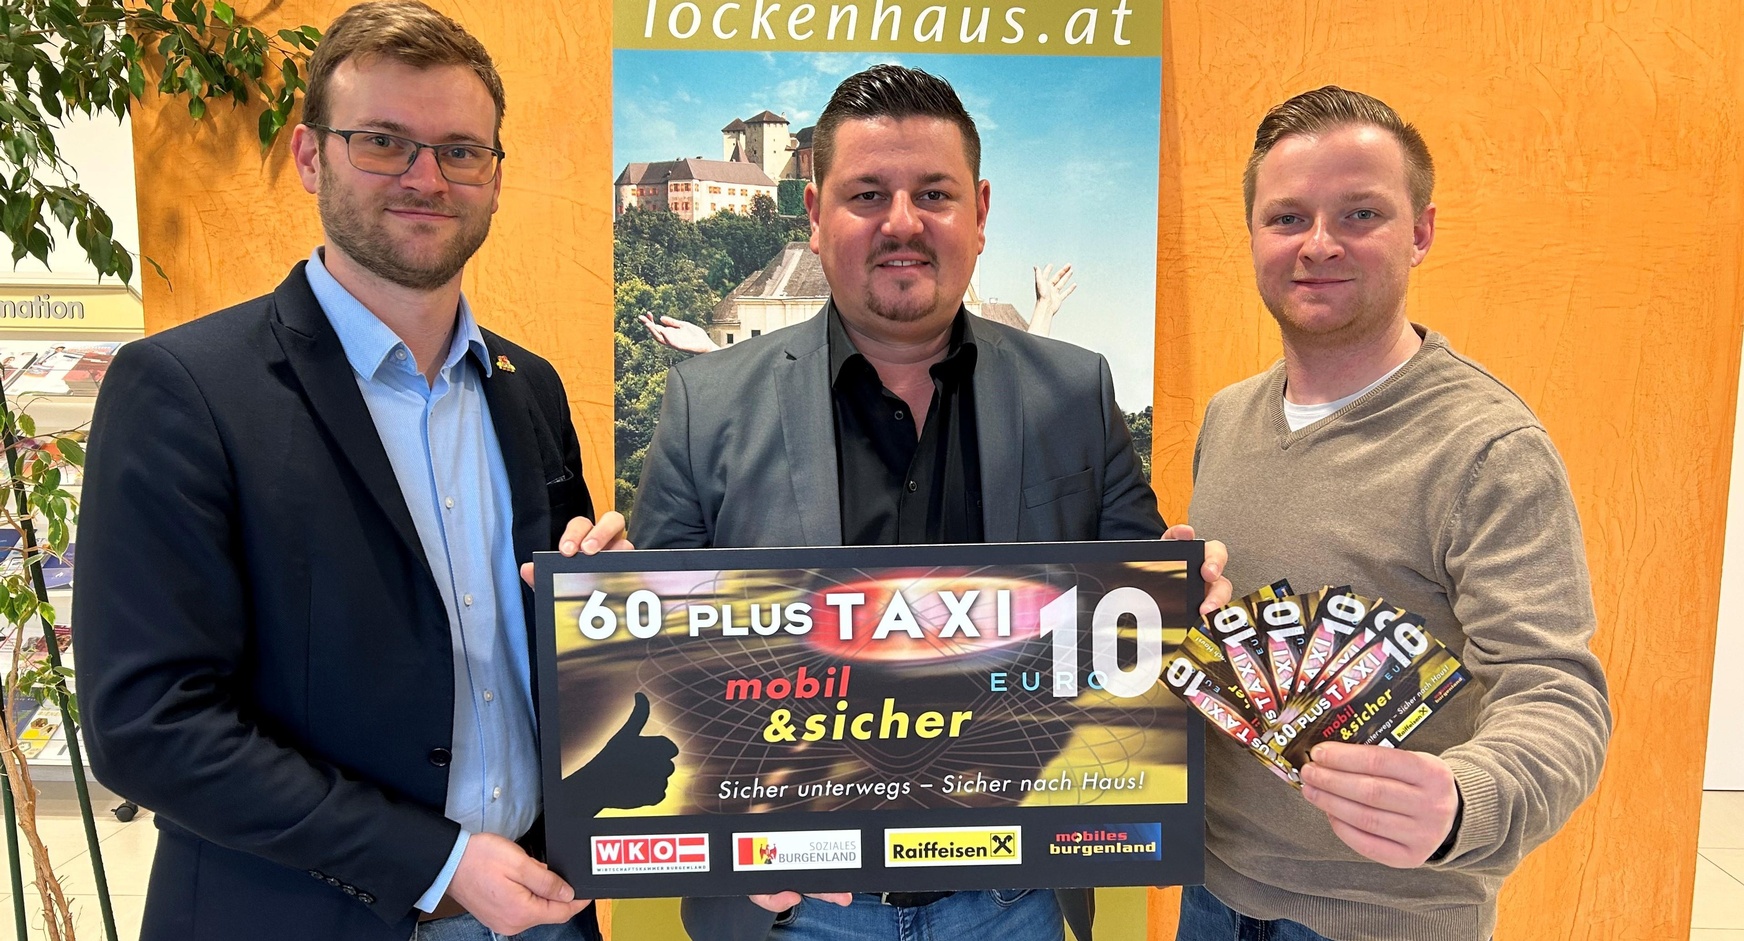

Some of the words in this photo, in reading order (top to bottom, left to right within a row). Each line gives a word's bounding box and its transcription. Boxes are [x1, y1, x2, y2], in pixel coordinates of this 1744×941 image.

[643, 0, 1133, 46] lockenhaus.at
[578, 589, 662, 640] 60
[689, 602, 813, 637] PLUS
[826, 589, 1011, 640] TAXI
[1214, 606, 1257, 648] 10
[1263, 601, 1306, 643] 10
[1322, 595, 1366, 635] 10
[1039, 585, 1163, 698] 10
[1381, 622, 1429, 668] 10
[725, 666, 851, 700] mobil
[990, 671, 1108, 692] EURO
[1167, 657, 1207, 698] 10
[1233, 653, 1271, 710] TAXI
[1273, 723, 1298, 747] 60
[1296, 698, 1331, 729] PLUS
[1326, 652, 1382, 701] TAXI
[1340, 688, 1394, 740] &sicher
[1397, 696, 1417, 715] Sicher
[1416, 682, 1432, 698] nach
[763, 698, 973, 743] &sicher
[1200, 696, 1251, 743] TAXI
[1322, 704, 1356, 739] mobil
[718, 778, 788, 799] Sicher
[798, 780, 911, 800] unterwegs
[942, 773, 1011, 793] Sicher
[1020, 771, 1072, 792] nach
[1082, 771, 1145, 790] Haus!
[597, 840, 674, 862] WKO
[809, 841, 857, 851] SOZIALES
[893, 842, 988, 859] Raiffeisen
[1050, 842, 1156, 856] burgenland
[1055, 831, 1128, 842] mobiles
[778, 852, 857, 863] BURGENLAND
